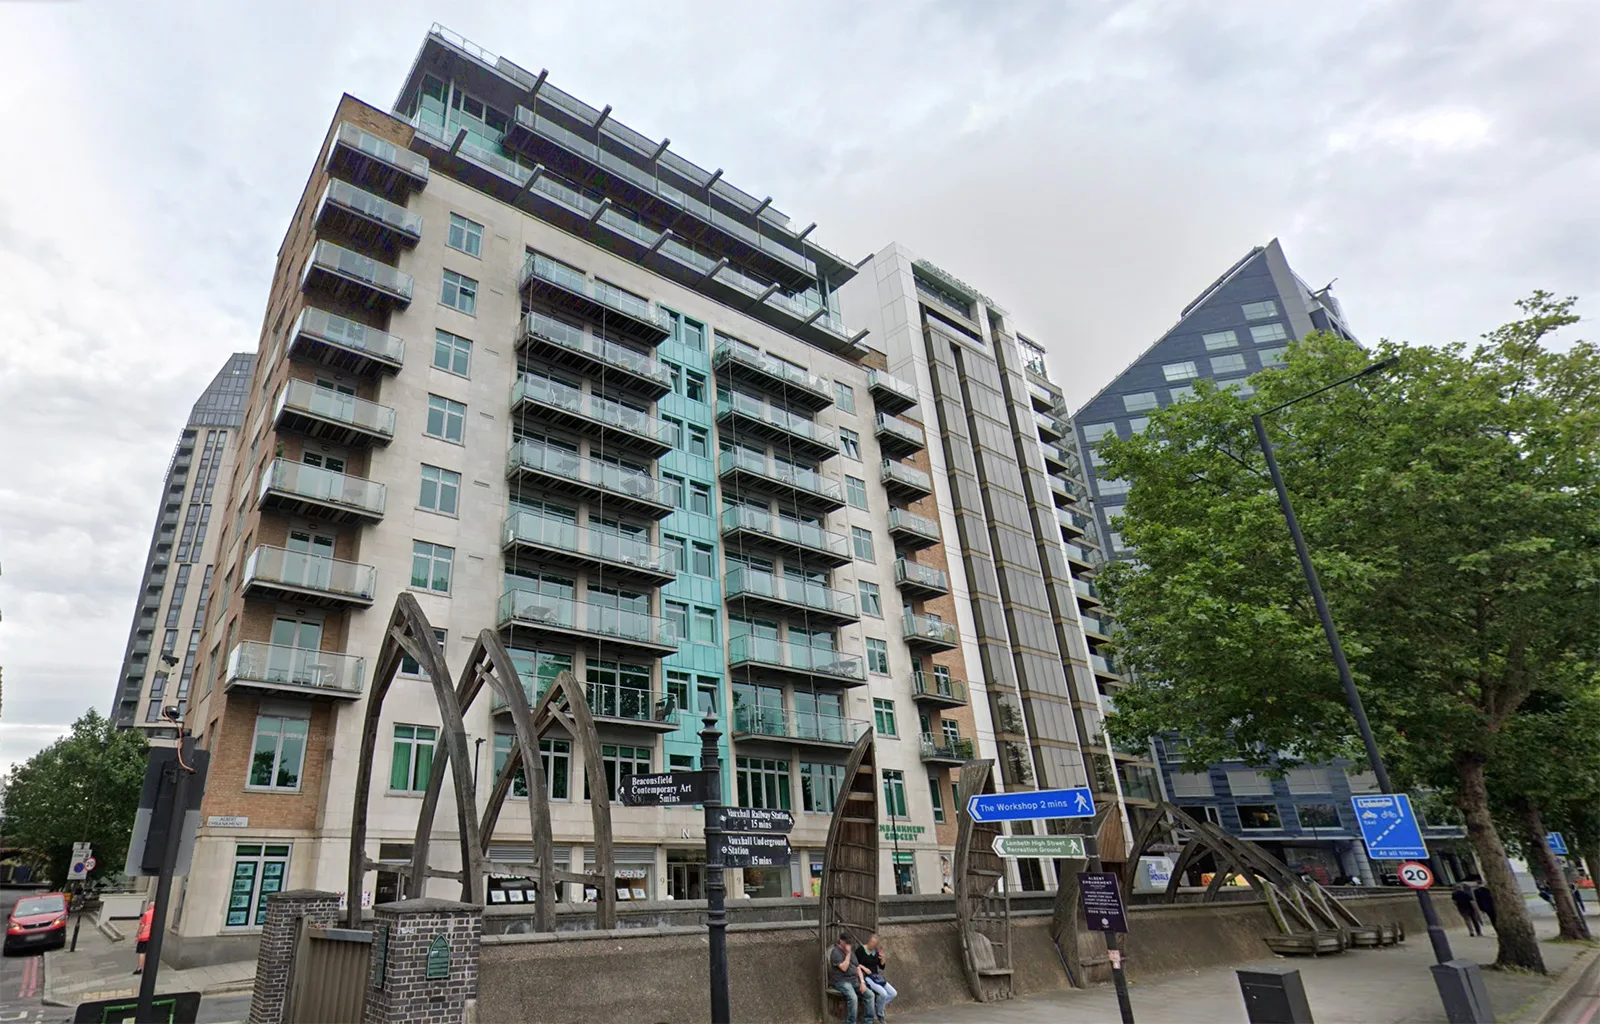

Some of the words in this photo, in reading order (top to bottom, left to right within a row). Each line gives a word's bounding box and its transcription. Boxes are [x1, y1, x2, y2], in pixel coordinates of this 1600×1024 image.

[631, 775, 673, 786] Beaconsfield
[631, 784, 677, 795] Contemporary
[680, 784, 692, 793] Art
[980, 804, 995, 813] The
[996, 801, 1038, 812] Workshop
[1040, 800, 1047, 809] 2
[1047, 799, 1068, 808] mins
[727, 808, 751, 818] Vauxhall
[751, 810, 771, 821] Railway
[771, 811, 789, 820] Station
[751, 819, 758, 828] 15
[758, 820, 772, 829] mins
[681, 828, 691, 839] N
[727, 835, 753, 846] Vauxhall
[753, 836, 787, 848] Underground
[727, 845, 749, 855] Station
[751, 856, 758, 865] 15
[758, 856, 772, 865] mins
[660, 876, 666, 885] 9
[736, 876, 742, 885] 9
[1404, 869, 1428, 881] 20
